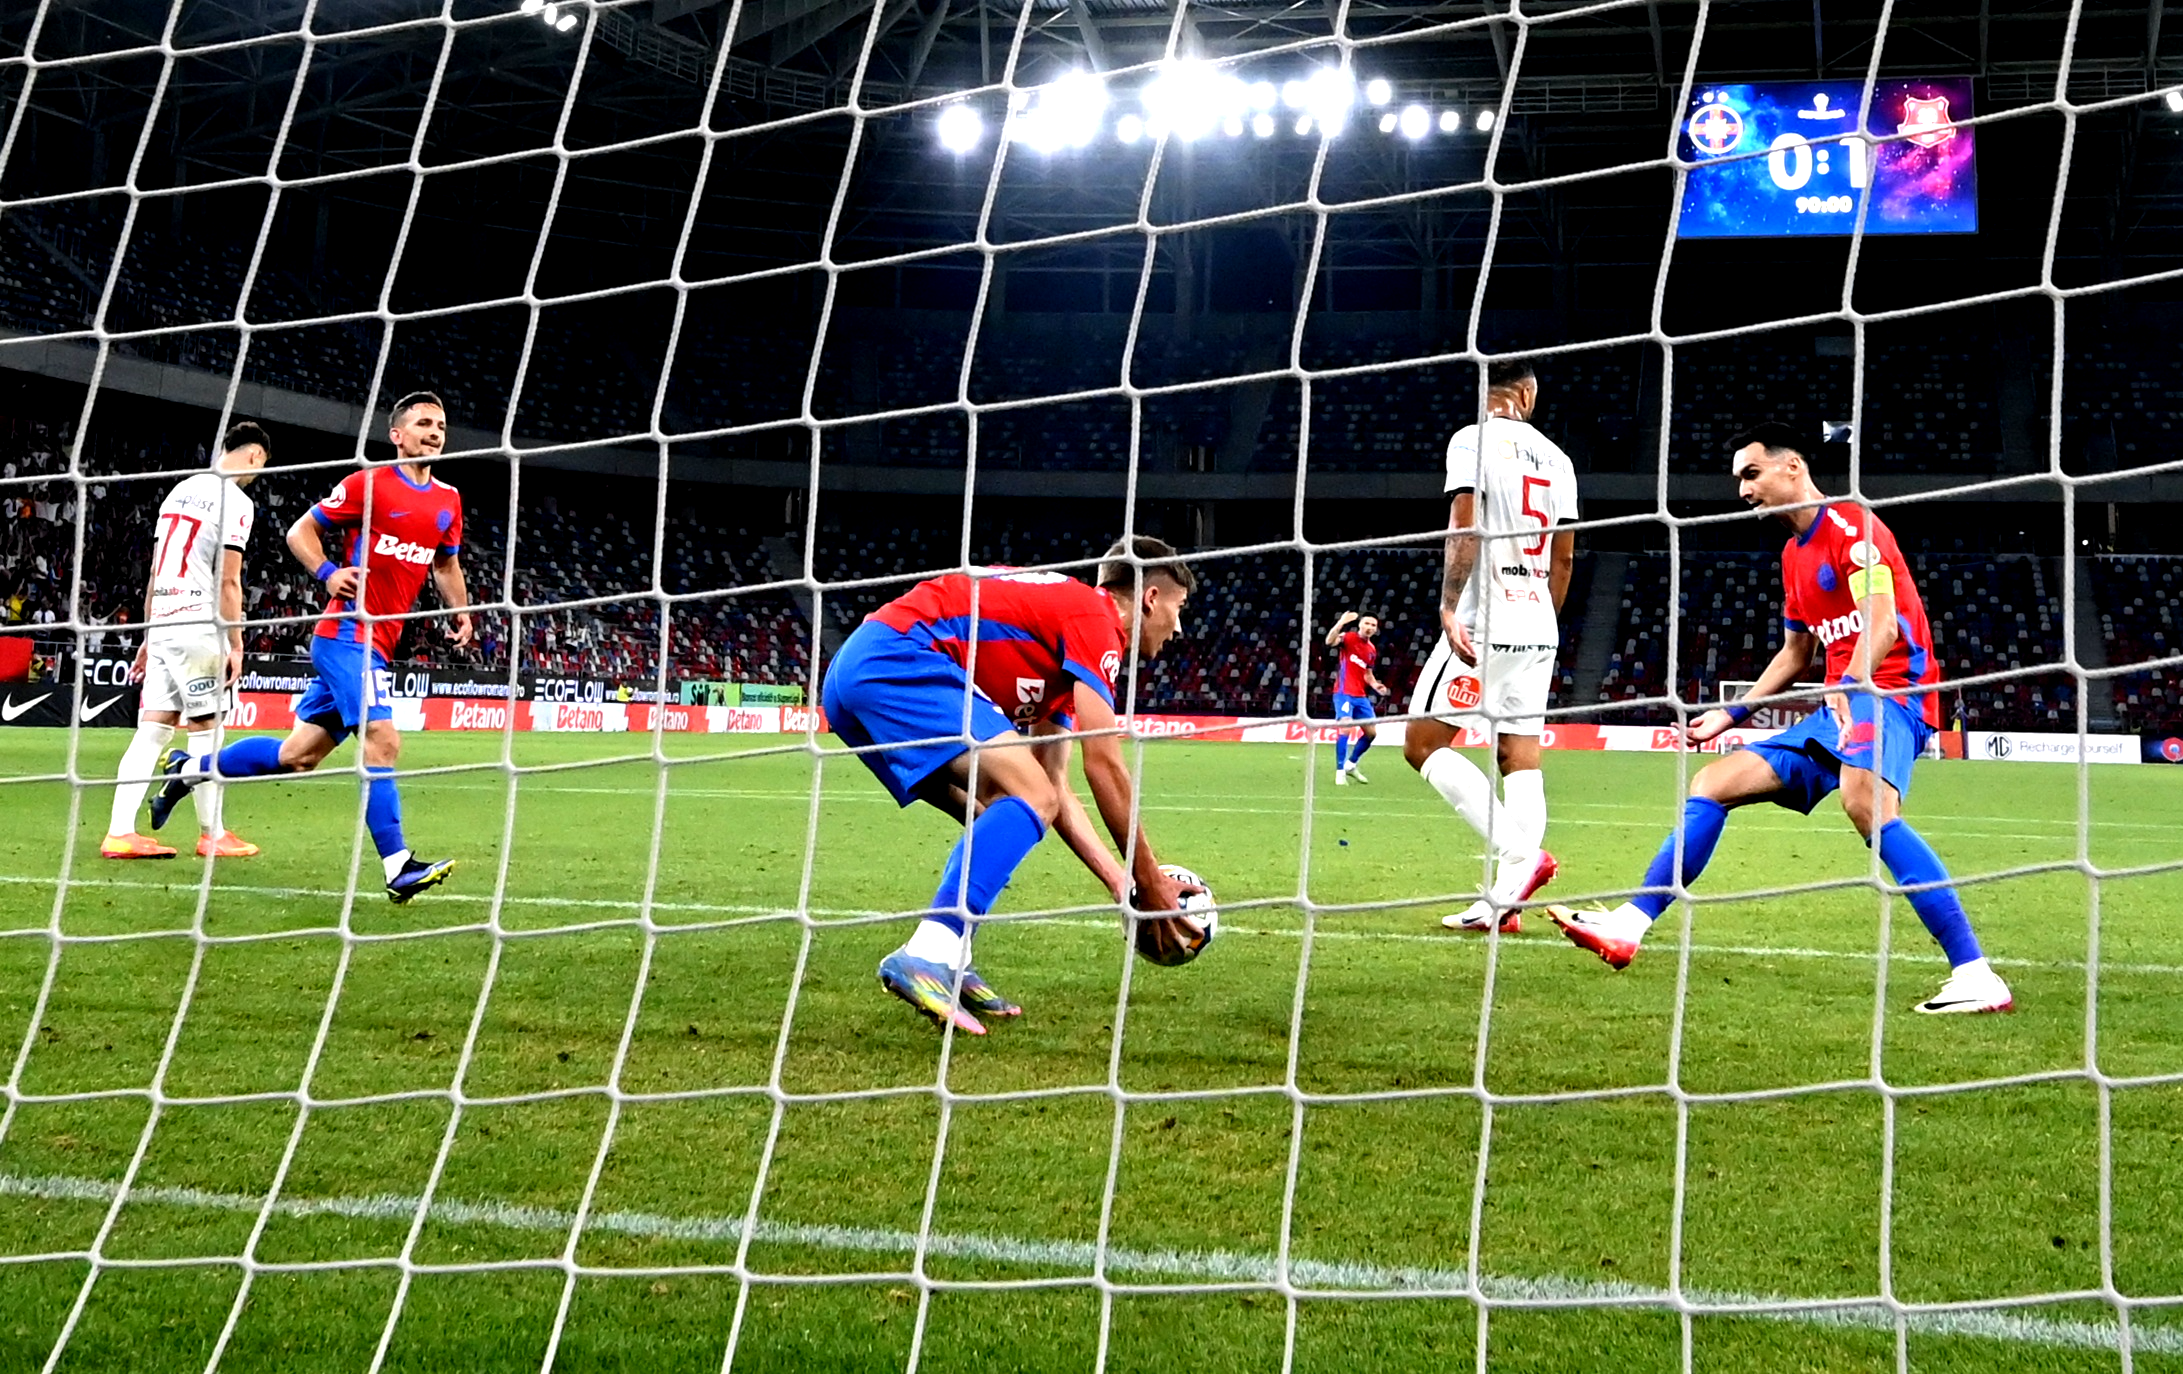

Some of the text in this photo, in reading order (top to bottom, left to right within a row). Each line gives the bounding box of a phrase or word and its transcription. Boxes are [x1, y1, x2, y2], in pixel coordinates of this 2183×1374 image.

[1795, 195, 1853, 214] 90:00
[1521, 474, 1552, 556] 5
[156, 512, 203, 579] 77
[188, 679, 216, 693] ODU
[361, 668, 391, 707] 15
[534, 678, 605, 703] ECOFLOW
[450, 701, 506, 729] Betano
[556, 704, 604, 729] Betano
[647, 706, 689, 730] Btano
[727, 709, 763, 731] Betano
[1987, 735, 2123, 757] MG Recharge ourself
